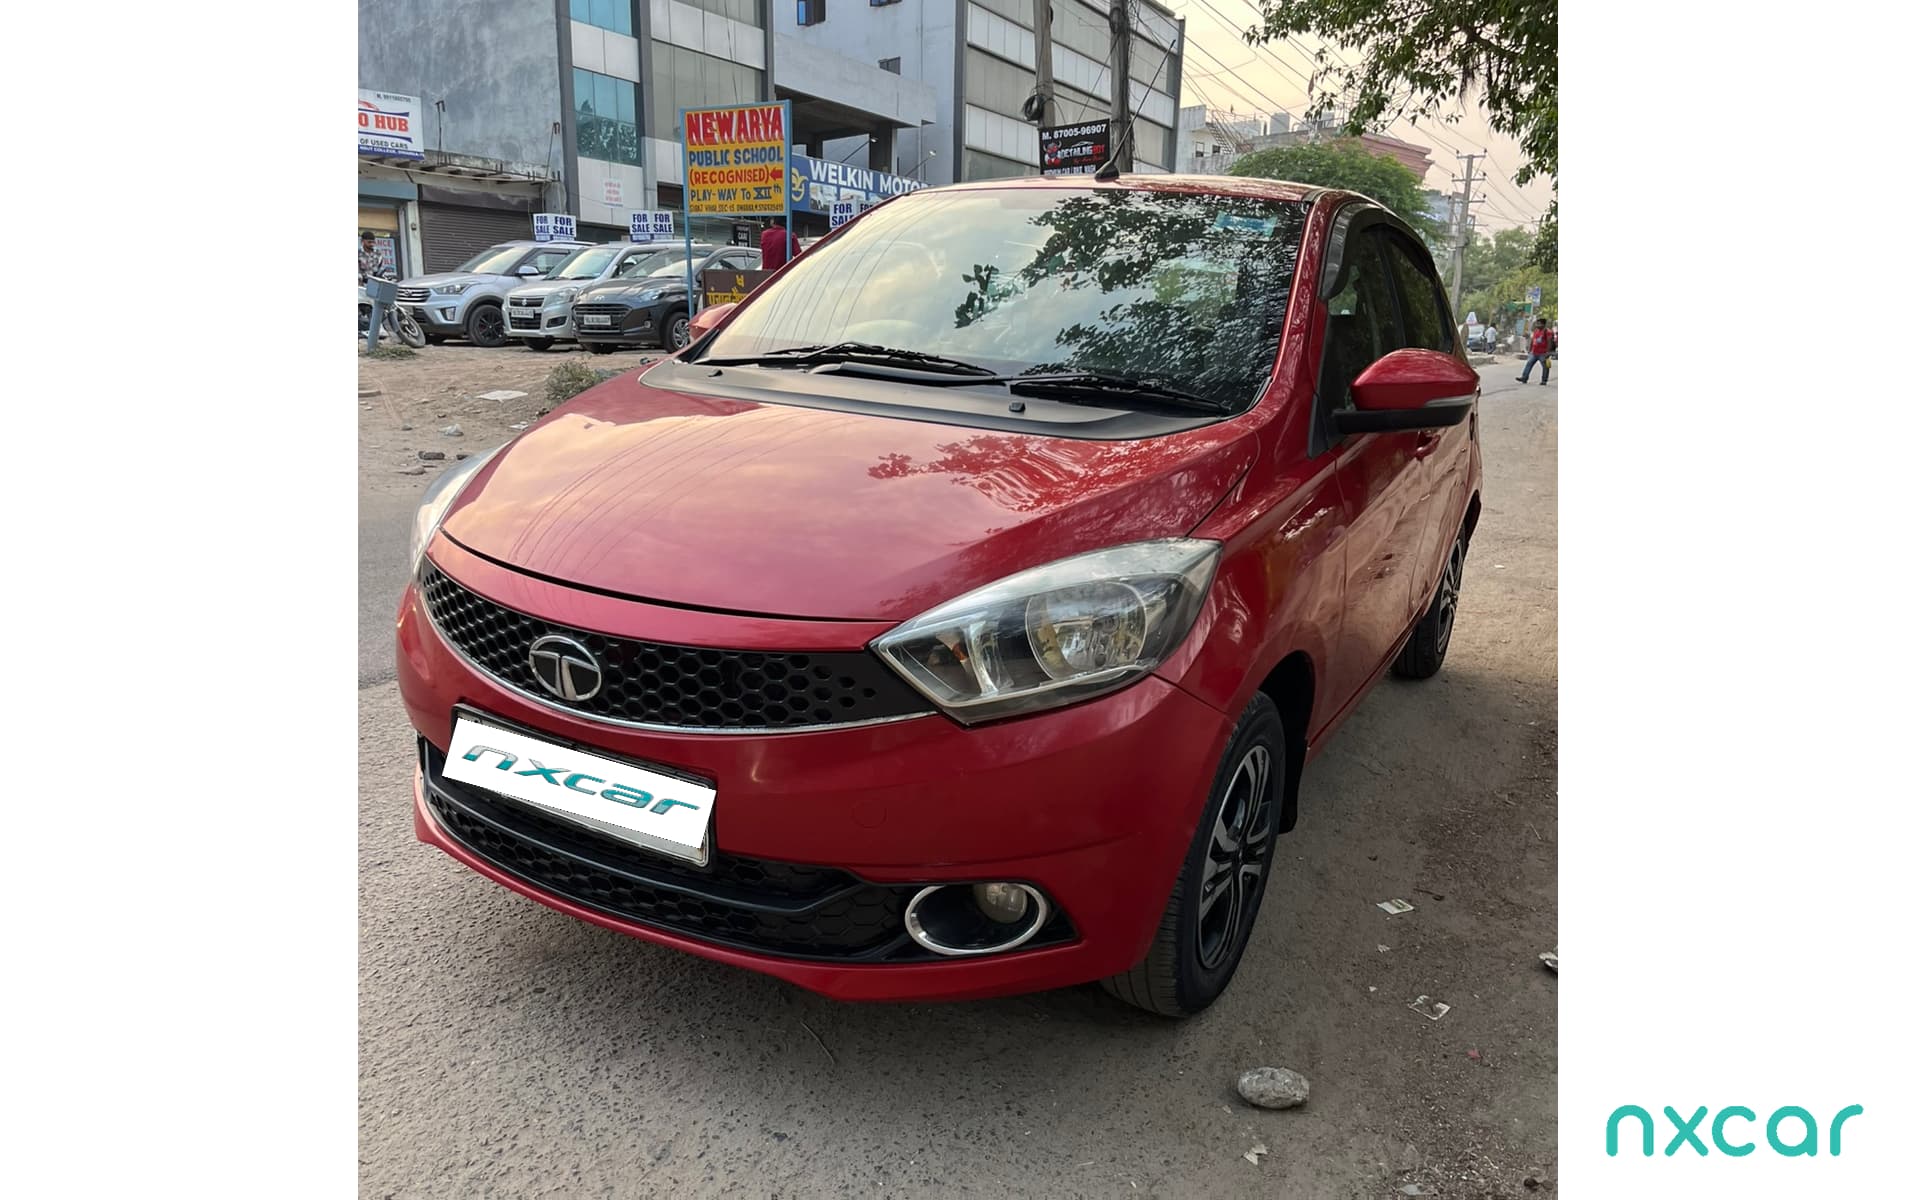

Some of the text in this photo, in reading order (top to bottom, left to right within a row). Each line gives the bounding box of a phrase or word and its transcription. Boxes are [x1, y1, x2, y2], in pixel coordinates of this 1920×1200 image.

[374, 114, 409, 132] HUB
[1042, 123, 1107, 140] M. 87005-96907
[370, 139, 389, 147] USED
[390, 142, 408, 150] CARS
[689, 146, 784, 166] PUBLIC SCHOOL
[690, 165, 769, 186] (RECOGNISED)
[809, 160, 873, 191] WELKIN
[834, 203, 852, 214] FOR
[536, 216, 548, 224] FOR
[554, 216, 572, 226] FOR
[633, 213, 648, 223] FOR
[654, 213, 670, 223] FOR
[536, 225, 549, 234] SALE
[553, 226, 574, 236] SALE
[632, 224, 650, 233] SALE
[653, 224, 672, 233] SALE
